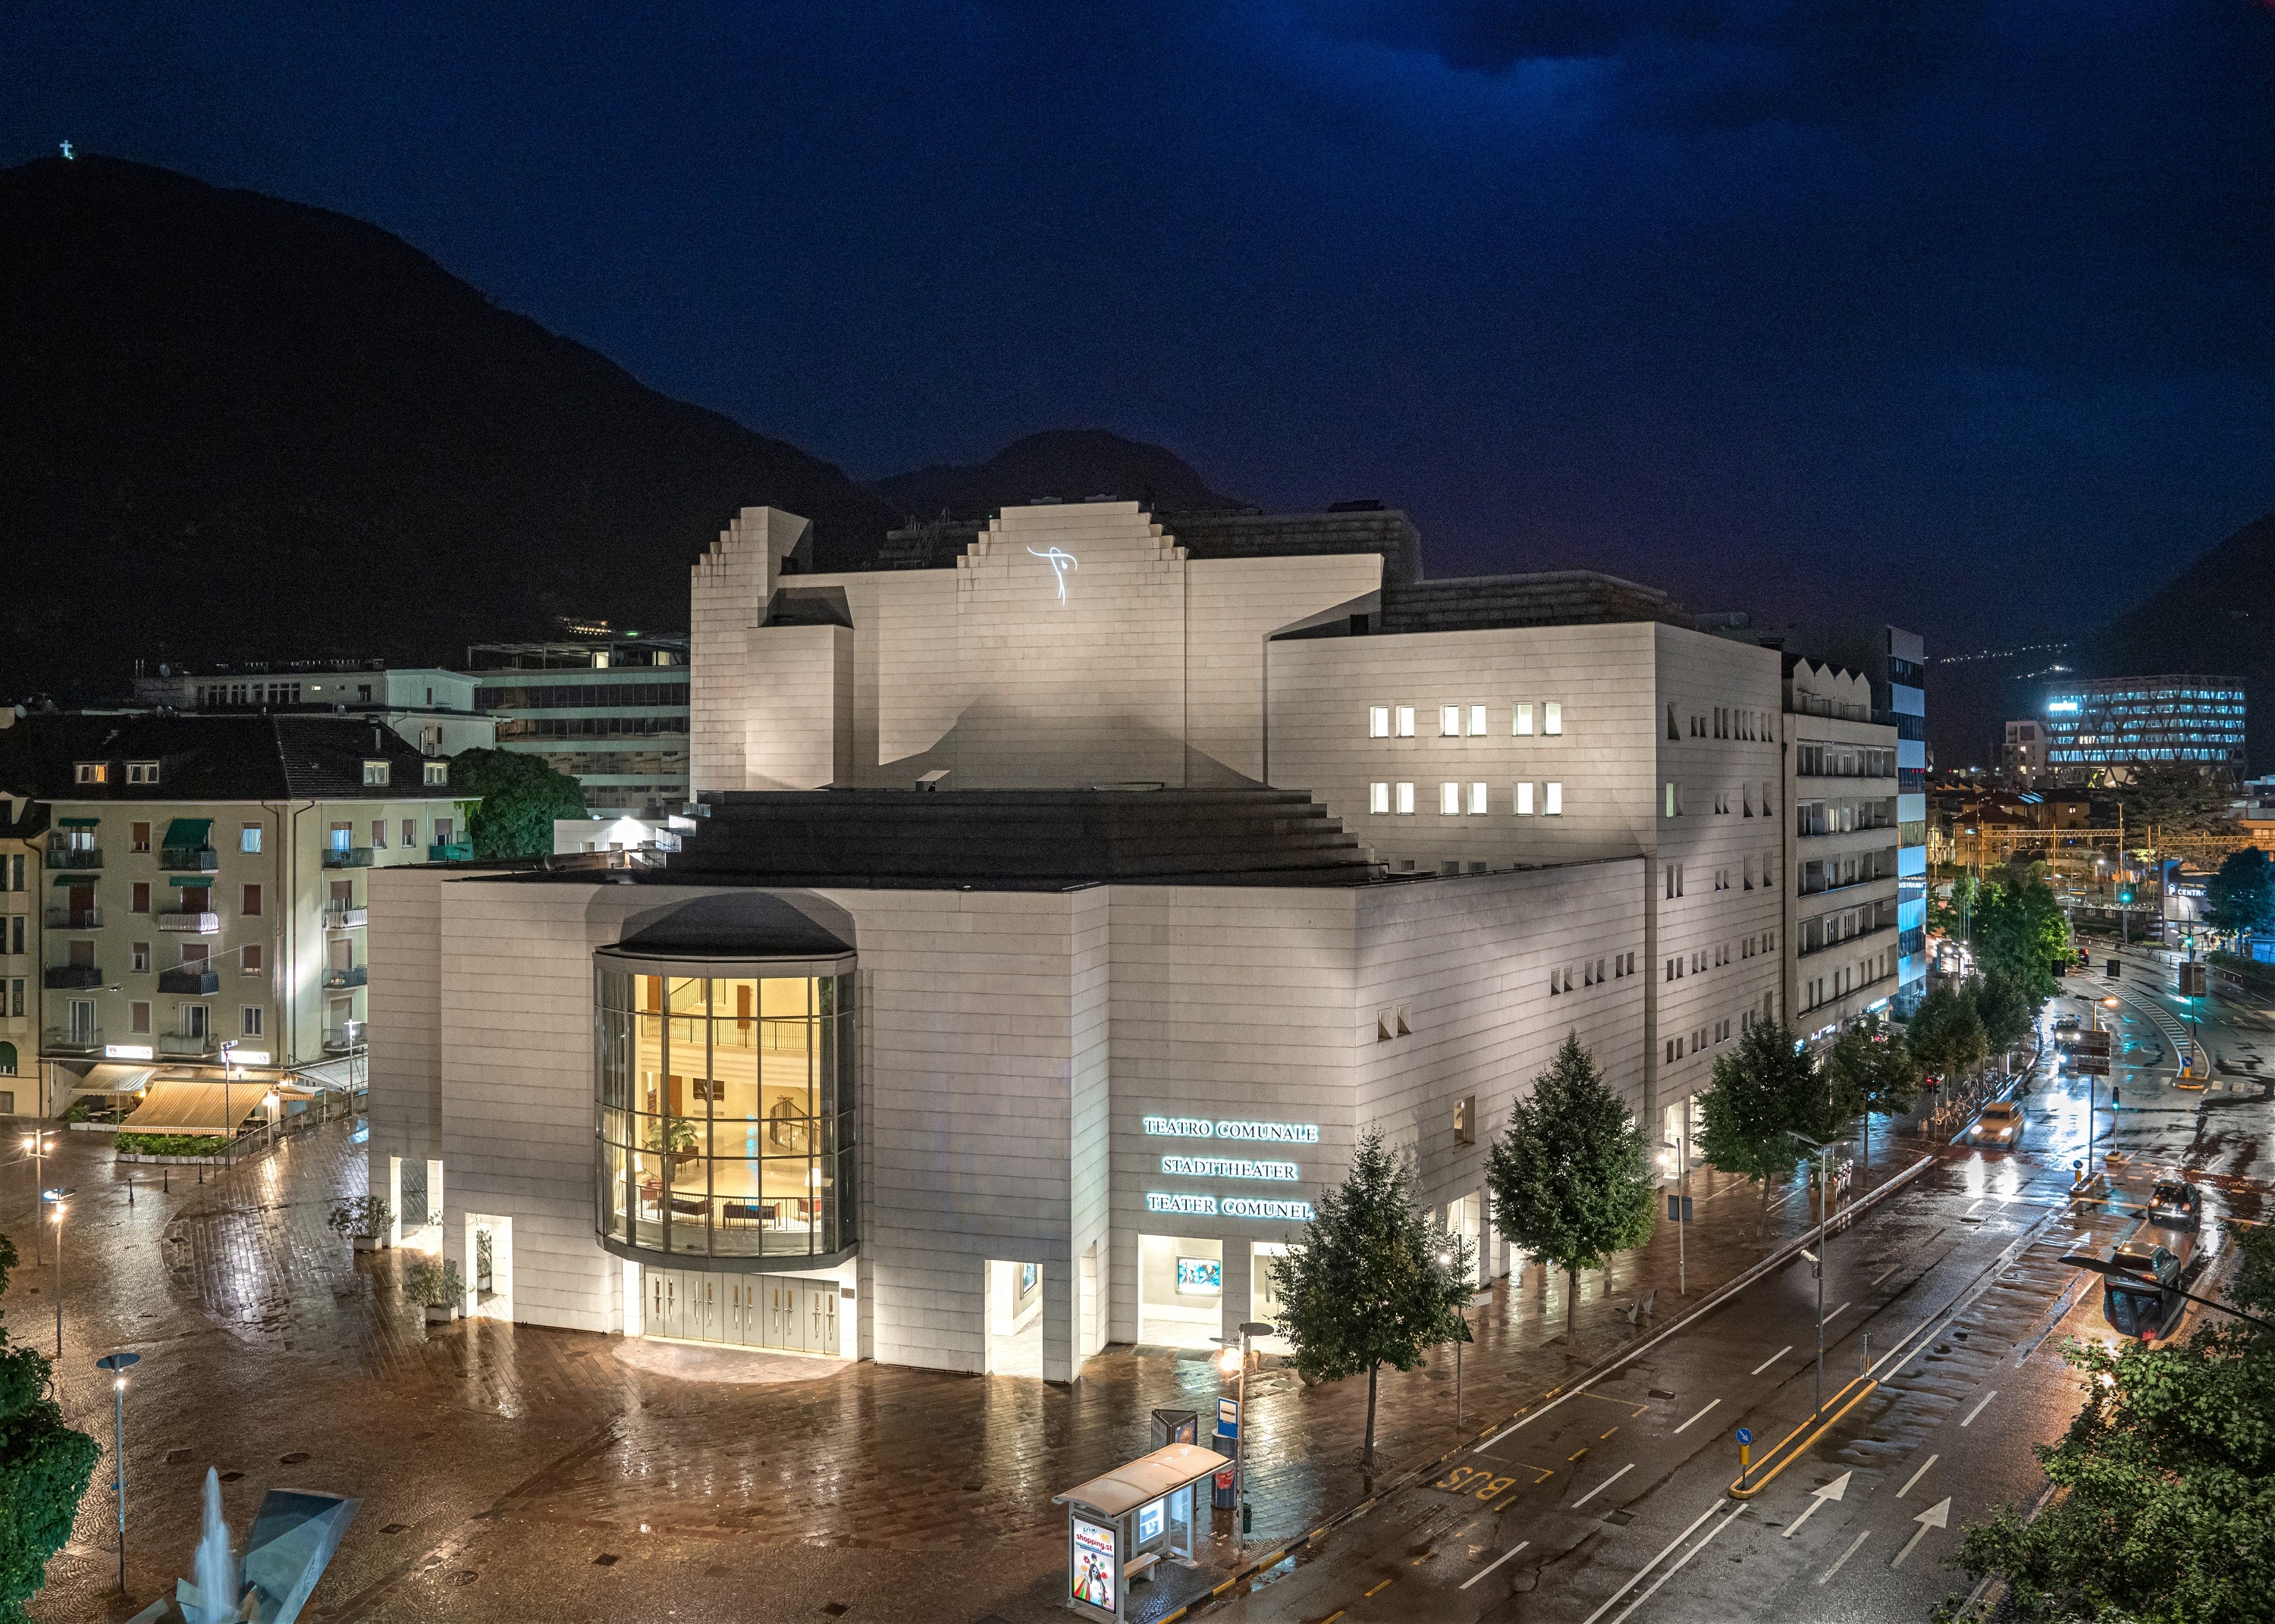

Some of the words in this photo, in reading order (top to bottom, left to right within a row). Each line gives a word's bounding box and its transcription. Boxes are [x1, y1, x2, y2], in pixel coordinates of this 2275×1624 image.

[1144, 1119, 1210, 1136] TEATRO
[1218, 1123, 1316, 1141] COMUNALE
[1163, 1158, 1295, 1179] STADTTHEATER
[1147, 1195, 1215, 1213] TEATER
[1437, 1467, 1516, 1500] BUS
[1076, 1533, 1113, 1552] shopping.st
